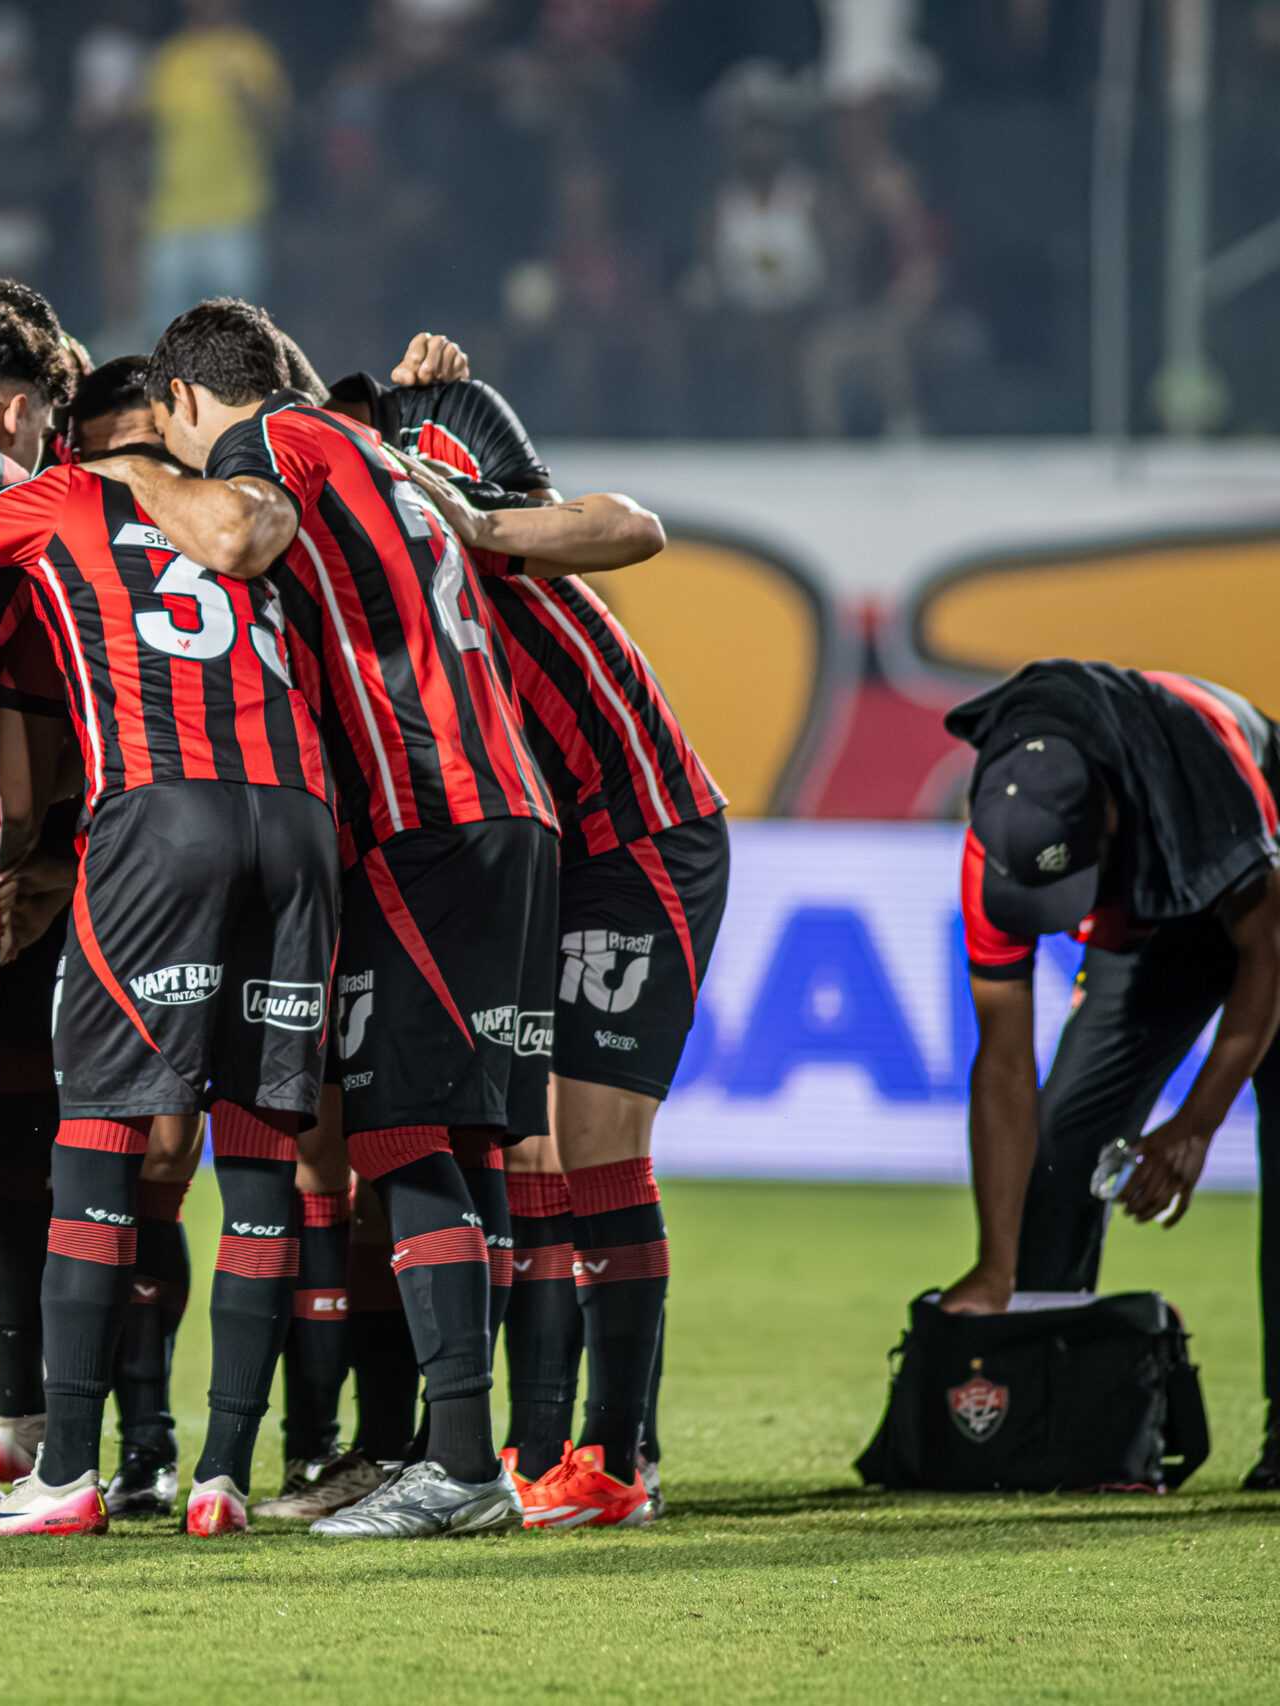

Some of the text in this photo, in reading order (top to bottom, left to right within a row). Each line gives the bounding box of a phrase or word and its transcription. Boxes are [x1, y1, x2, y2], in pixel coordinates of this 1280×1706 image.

[144, 532, 170, 546] SB
[608, 931, 654, 955] Brasil
[185, 963, 224, 990] BLU
[164, 989, 206, 1002] TINTAS
[520, 1022, 554, 1052] Iqu
